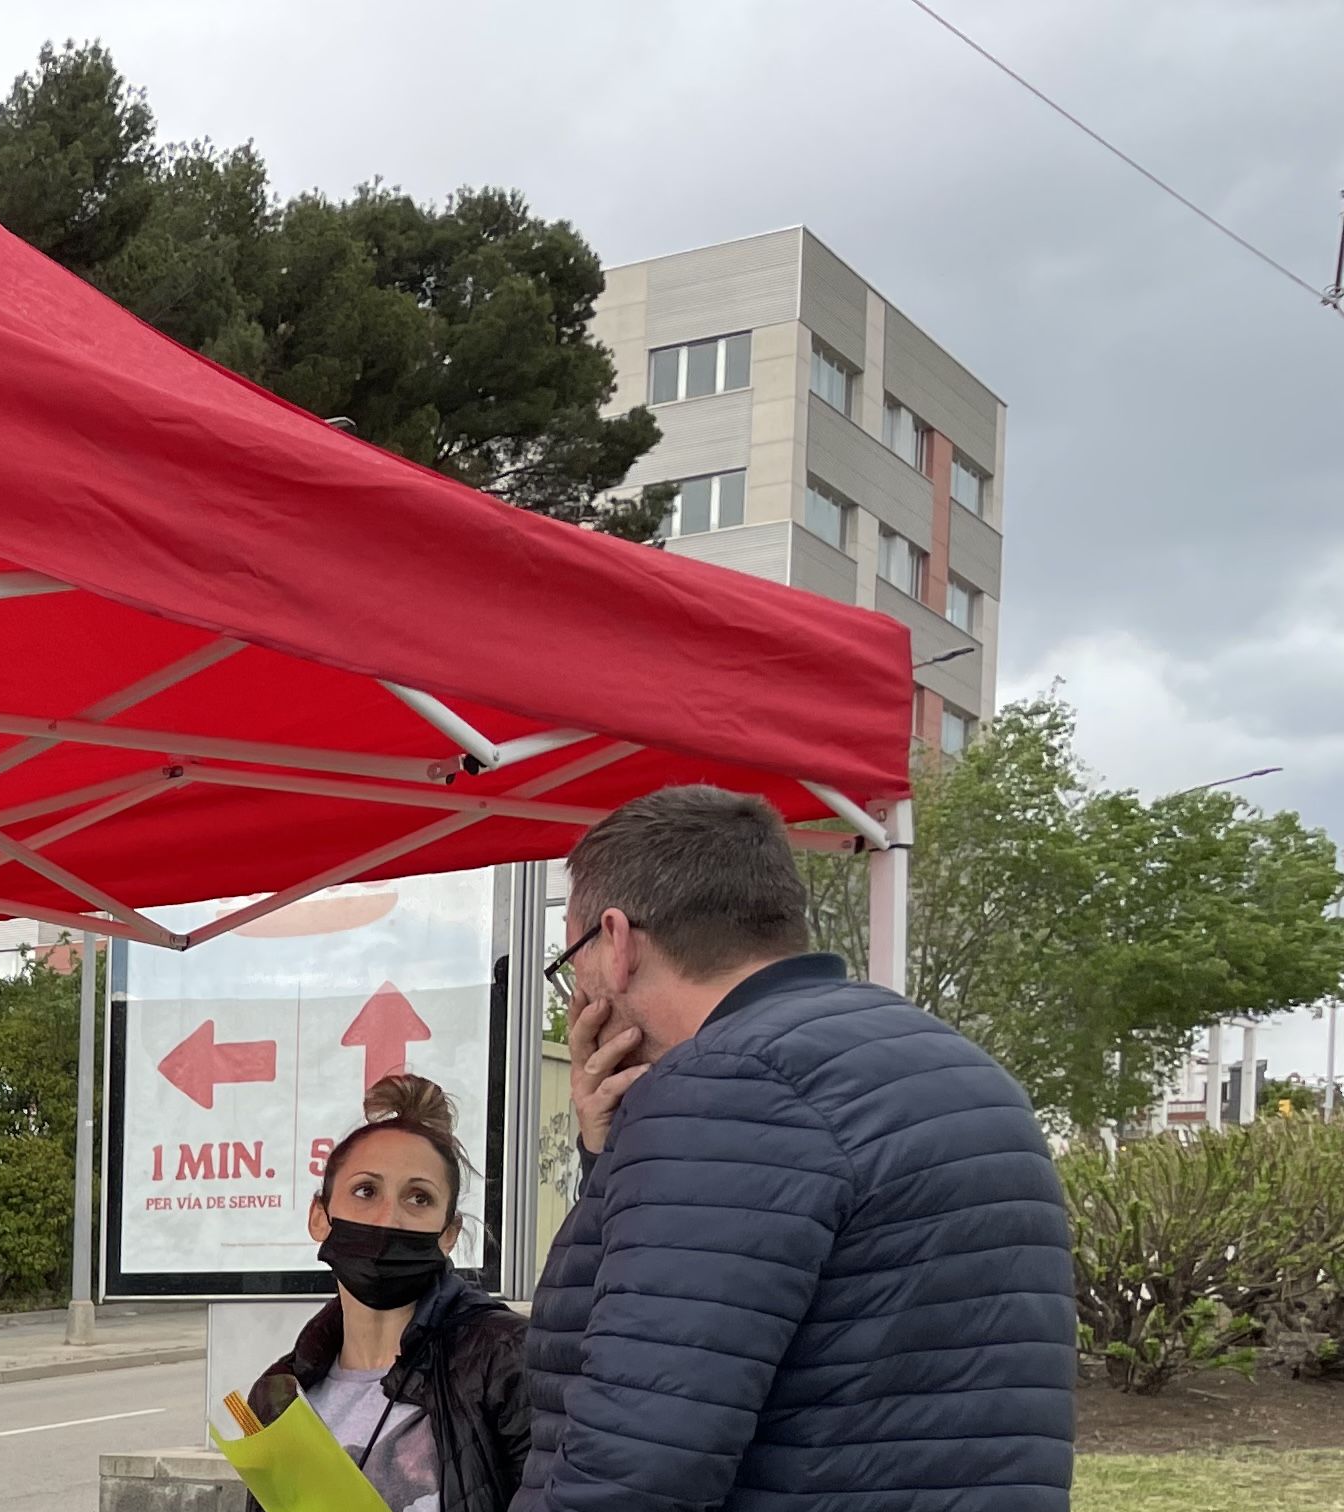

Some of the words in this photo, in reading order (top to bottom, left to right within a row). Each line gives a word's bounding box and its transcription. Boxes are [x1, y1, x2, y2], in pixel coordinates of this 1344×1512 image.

[175, 1140, 276, 1181] MIN.
[146, 1197, 172, 1210] PER
[176, 1193, 203, 1210] VÍA
[206, 1196, 226, 1209] DE
[227, 1194, 282, 1209] SERVEI
